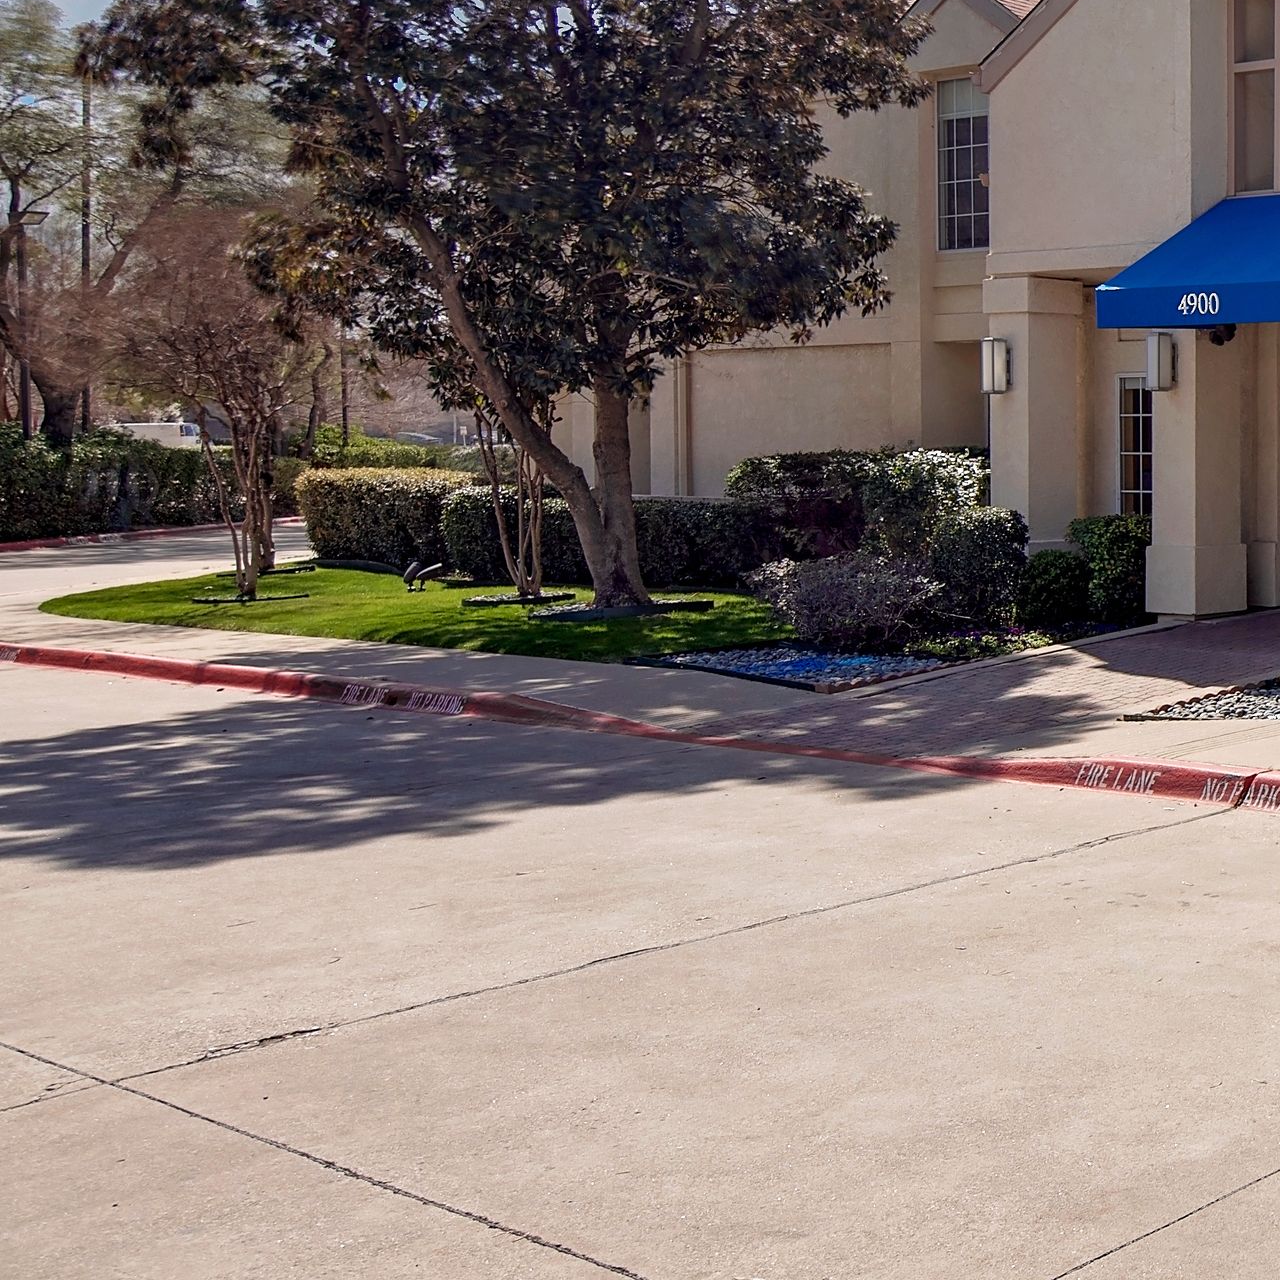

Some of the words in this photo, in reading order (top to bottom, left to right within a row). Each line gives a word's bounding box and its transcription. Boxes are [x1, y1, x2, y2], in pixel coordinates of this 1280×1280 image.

[1177, 292, 1219, 315] 4900
[341, 684, 364, 704] FIRE
[362, 687, 389, 705] LANE
[406, 691, 424, 711] NO
[422, 693, 467, 714] PARKING
[1075, 761, 1114, 788] FIRE
[1112, 767, 1161, 795] LANE
[1200, 778, 1229, 802] NO
